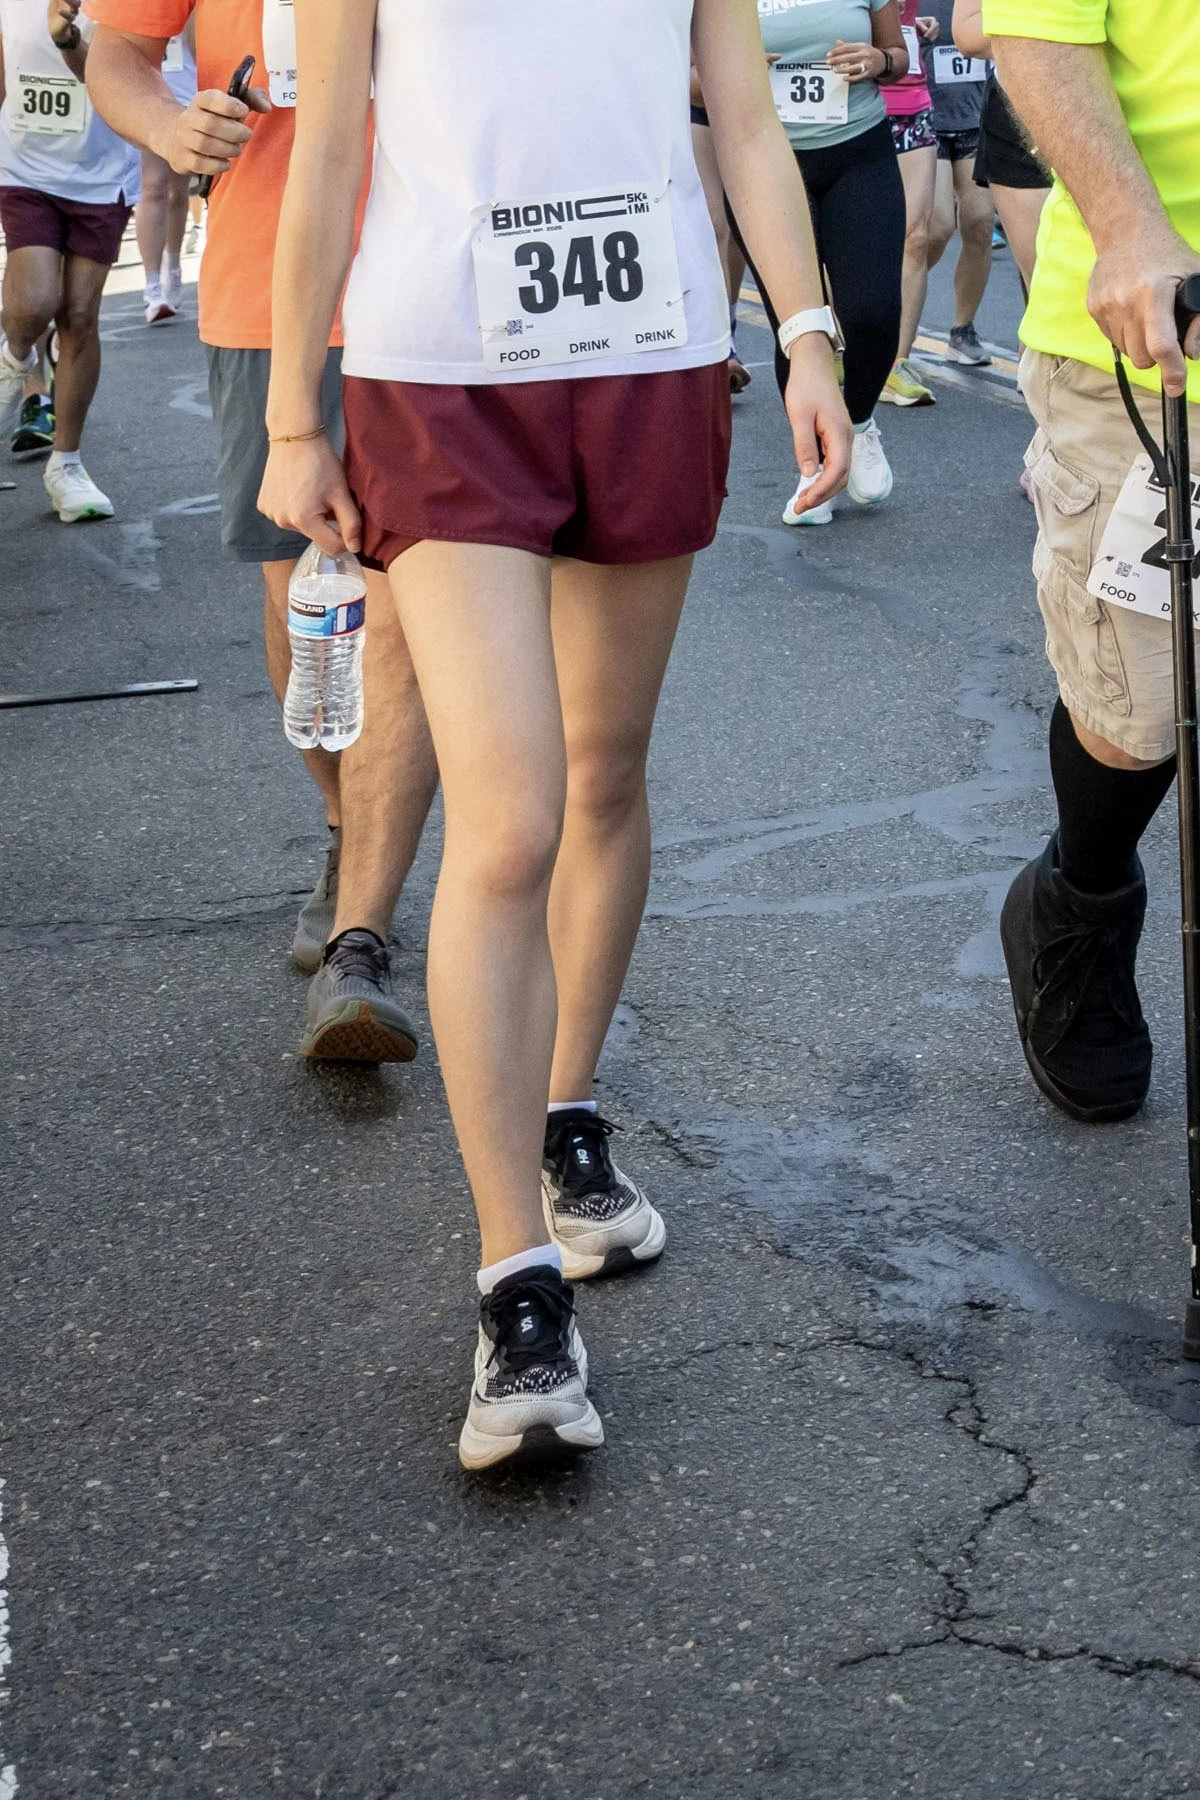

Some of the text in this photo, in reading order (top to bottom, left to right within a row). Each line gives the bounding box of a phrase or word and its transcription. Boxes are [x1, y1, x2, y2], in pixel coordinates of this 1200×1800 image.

[19, 74, 68, 86] BIONIC
[951, 57, 972, 76] 67
[23, 88, 70, 117] 309
[282, 91, 297, 100] FO
[790, 75, 825, 104] 33
[491, 195, 627, 231] BIONIC
[514, 230, 643, 314] 348
[499, 329, 676, 363] FOOD DRINK DRINK
[1099, 582, 1137, 603] FOOD
